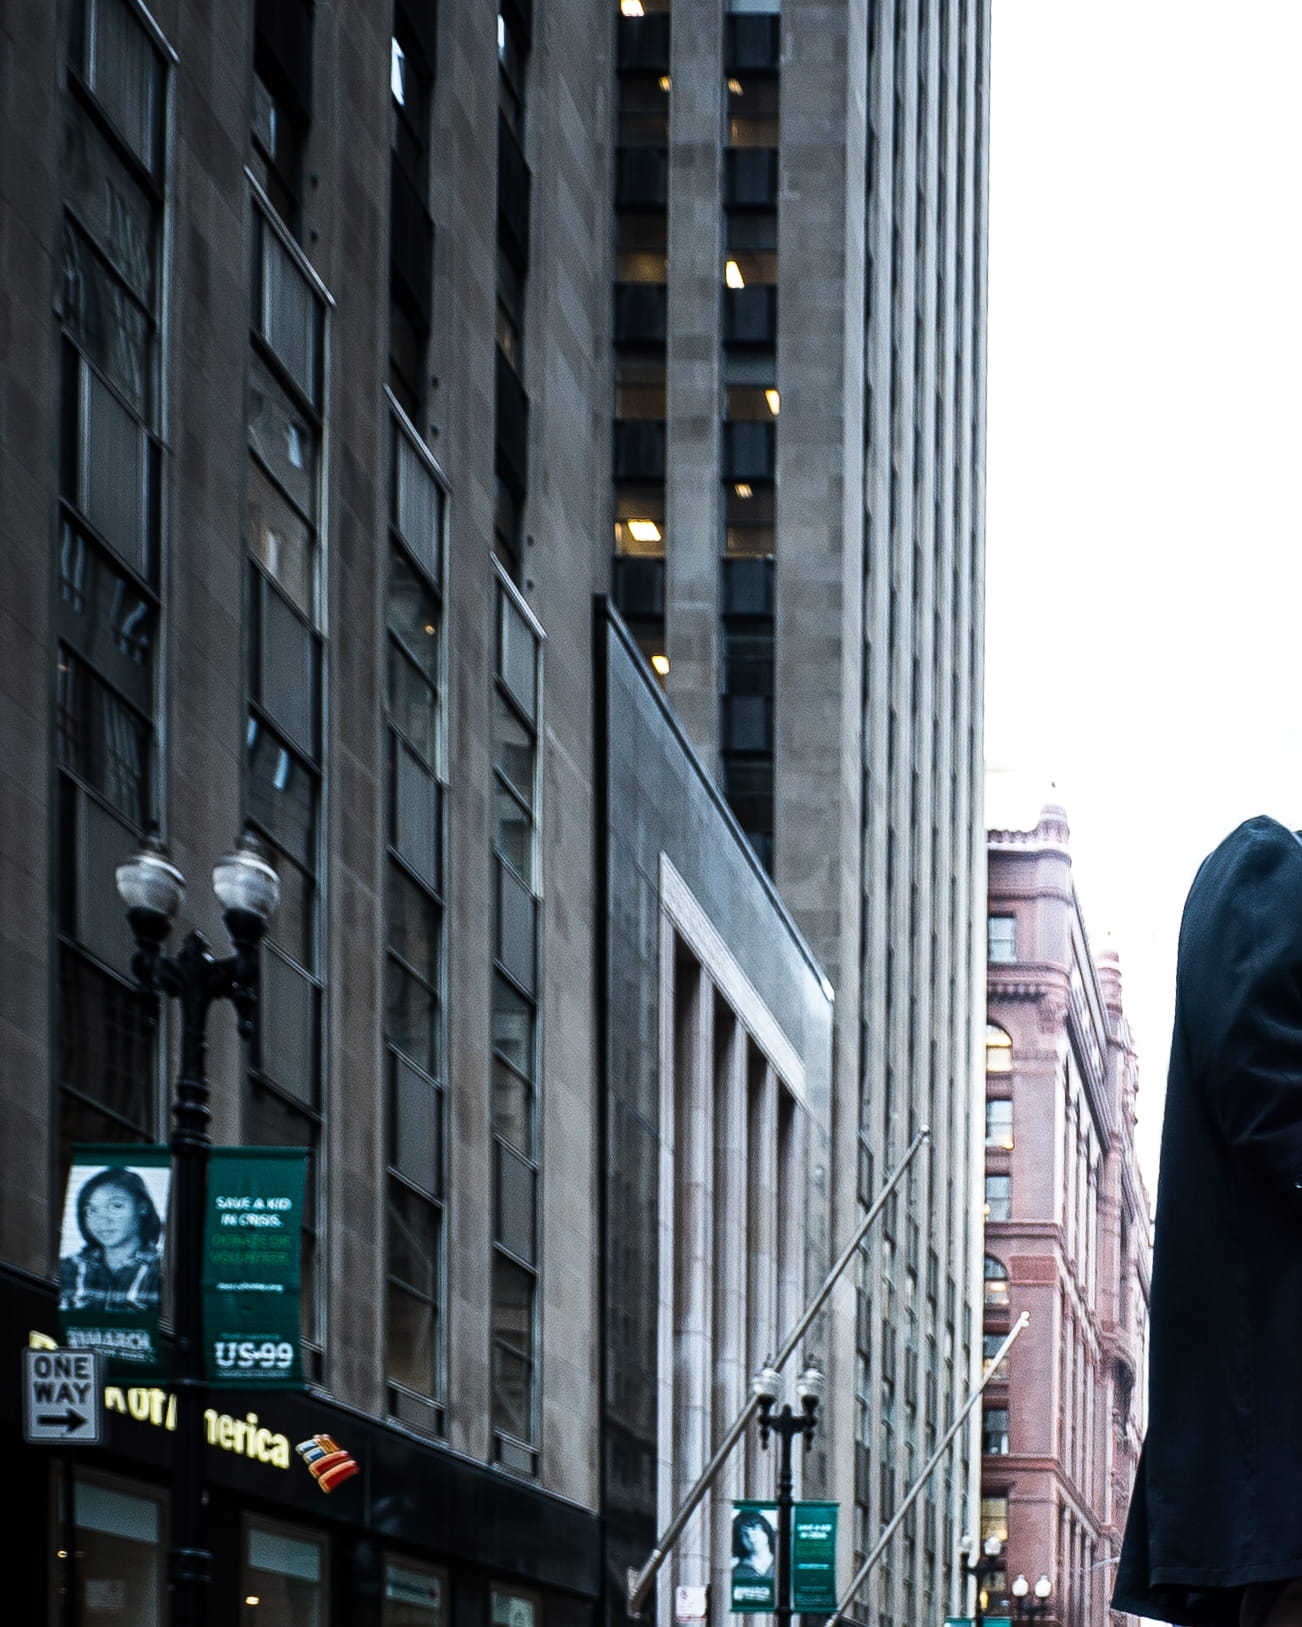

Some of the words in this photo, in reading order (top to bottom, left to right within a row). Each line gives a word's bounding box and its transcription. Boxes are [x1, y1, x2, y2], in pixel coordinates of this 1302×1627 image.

[215, 1196, 251, 1210] SAVE
[252, 1197, 265, 1210] A
[221, 1213, 238, 1226] IN
[34, 1356, 90, 1379] ONE
[33, 1382, 92, 1404] WAY
